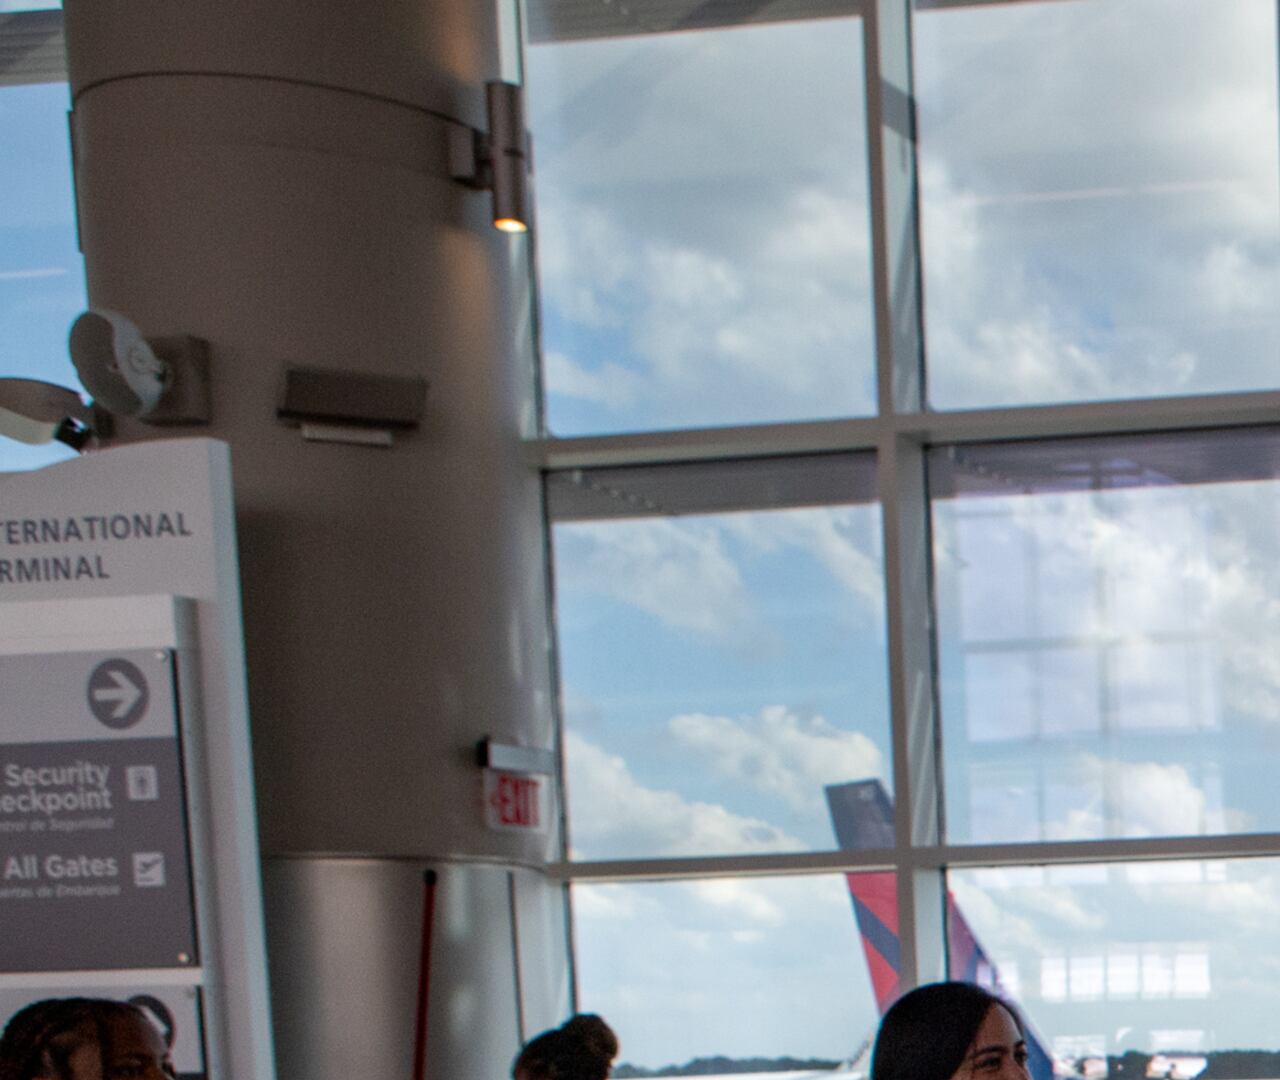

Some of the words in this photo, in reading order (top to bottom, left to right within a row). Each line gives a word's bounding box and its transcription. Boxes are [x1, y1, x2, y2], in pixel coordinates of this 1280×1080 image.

[5, 761, 110, 790] Security
[0, 787, 112, 815] eckpoint
[4, 855, 38, 879] All
[46, 855, 119, 878] Gates
